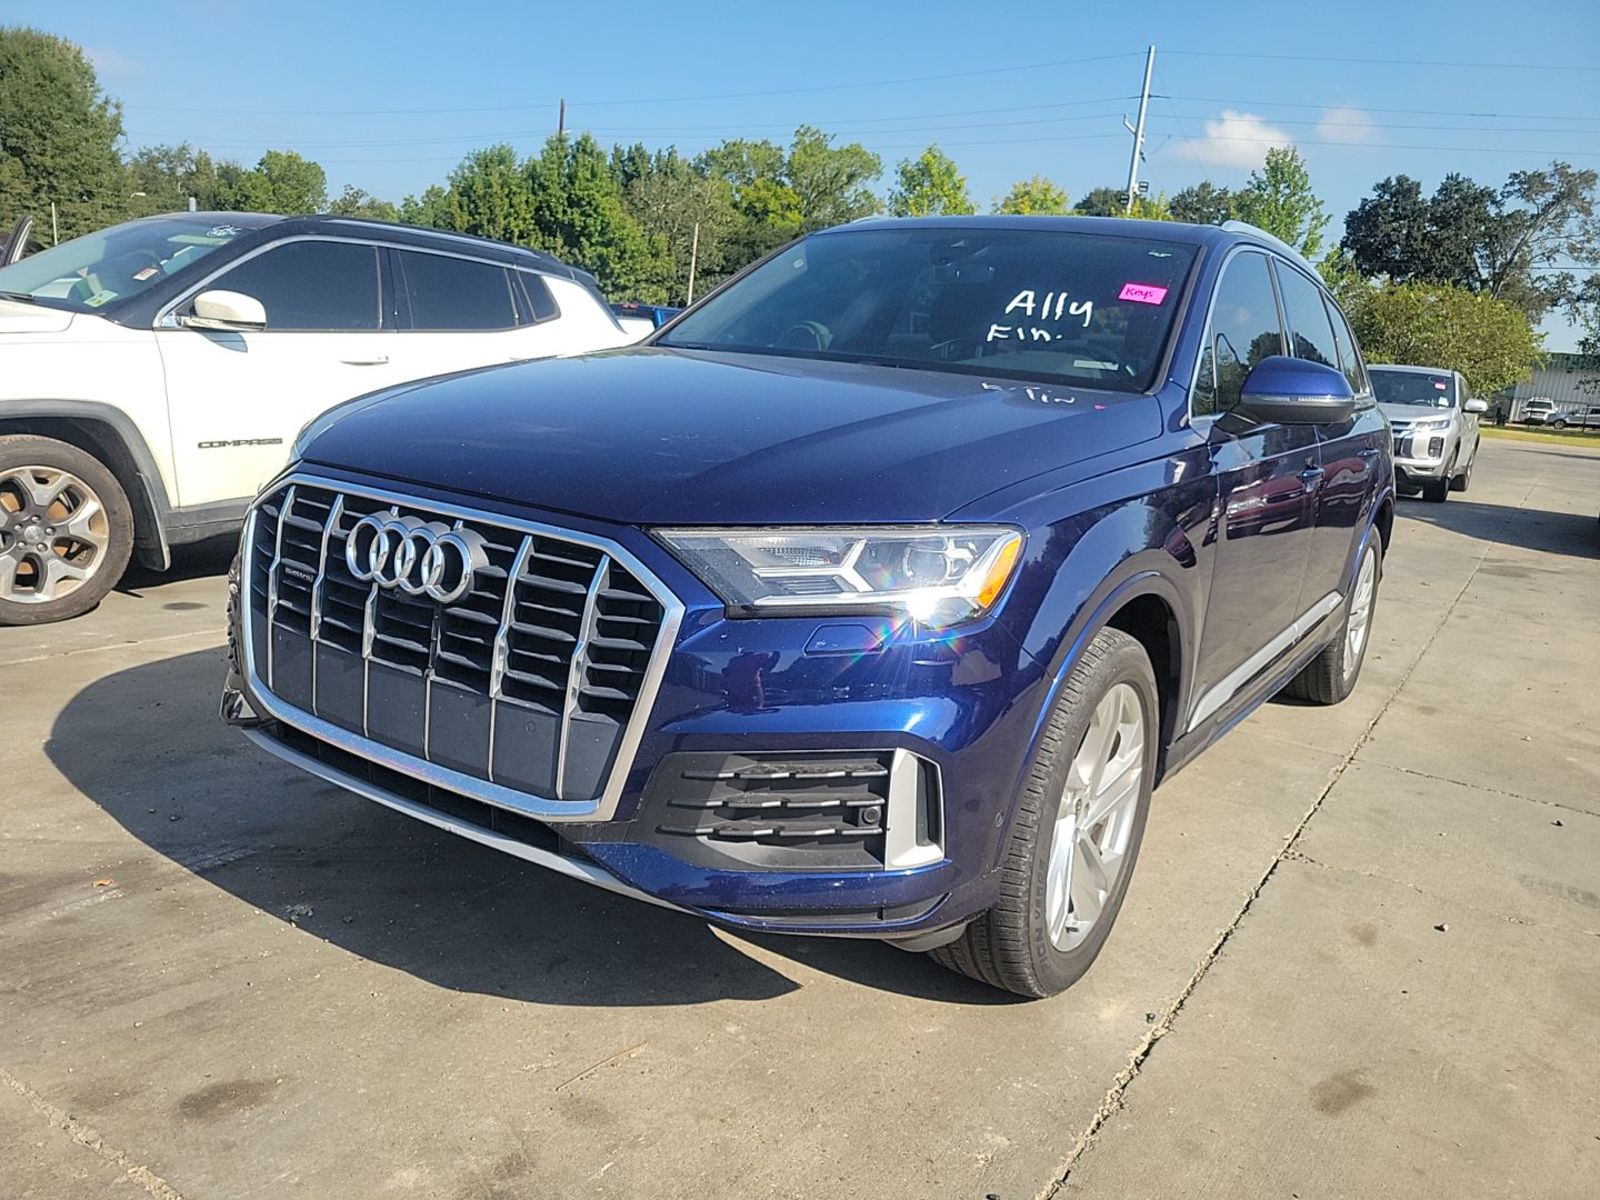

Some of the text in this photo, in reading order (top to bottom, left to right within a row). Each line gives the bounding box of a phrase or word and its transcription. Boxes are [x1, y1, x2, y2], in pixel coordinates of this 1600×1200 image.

[1125, 287, 1154, 300] Keys
[1004, 290, 1094, 328] Ally
[197, 438, 283, 449] COMPASS
